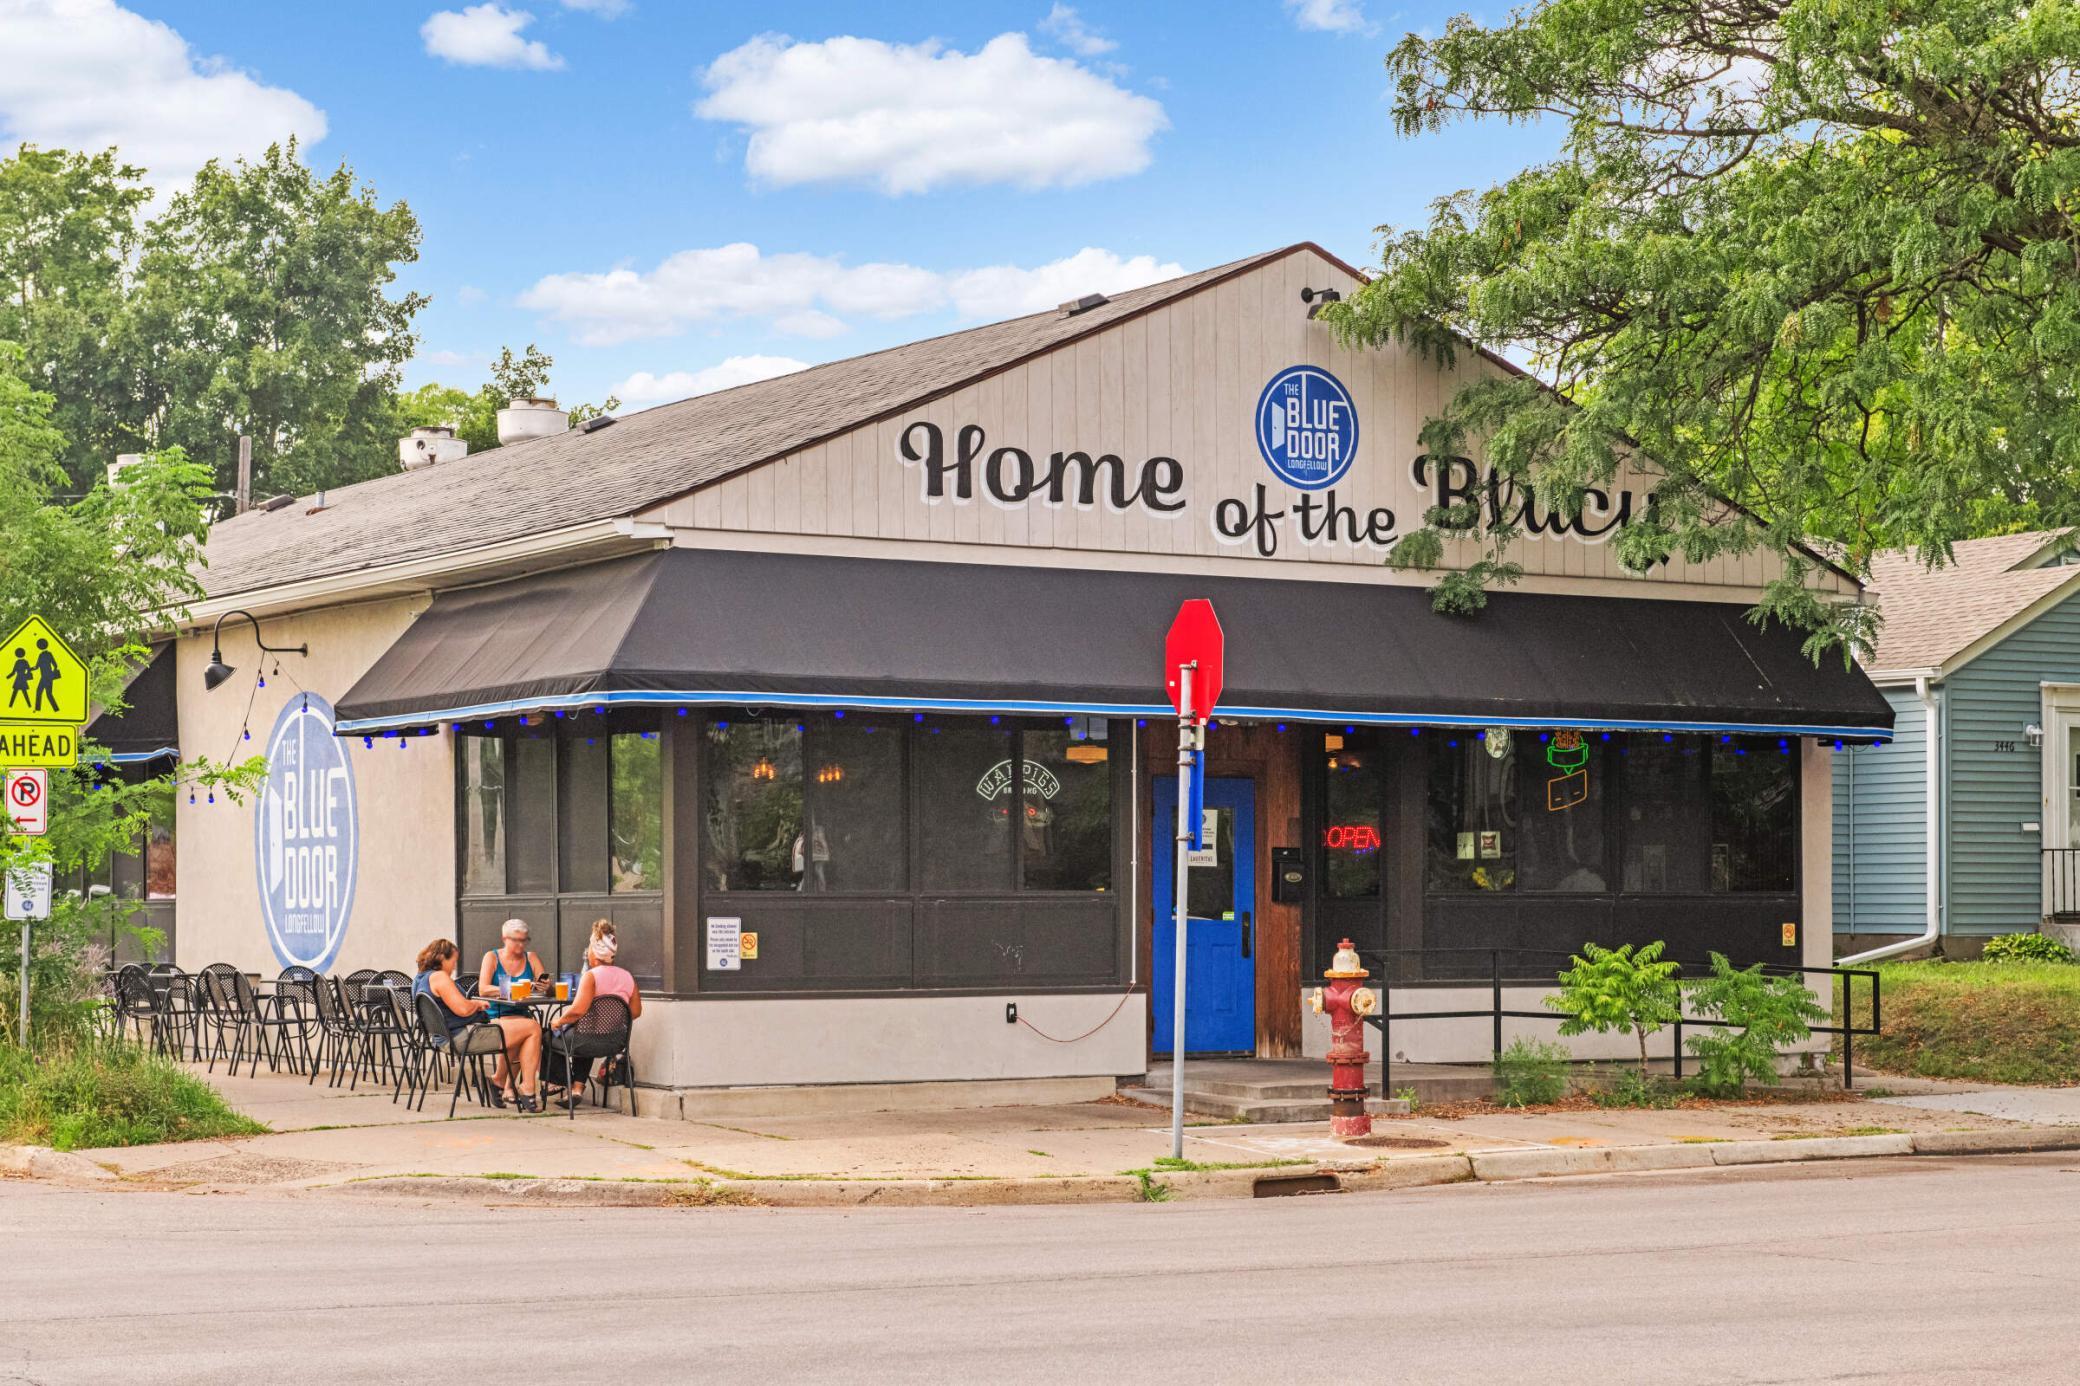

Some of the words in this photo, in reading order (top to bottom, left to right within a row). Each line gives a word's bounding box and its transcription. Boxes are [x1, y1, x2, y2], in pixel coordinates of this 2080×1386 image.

[1284, 383, 1299, 396] THE
[1287, 397, 1346, 431] BLUE
[1287, 430, 1340, 463] DOOR
[1287, 459, 1328, 471] LONGFELLOW
[899, 421, 1187, 512] Home
[1216, 482, 1285, 557] of
[1292, 489, 1399, 546] the
[0, 734, 71, 757] AHEAD
[282, 739, 297, 766] THE
[284, 768, 344, 840] BLUE
[1326, 825, 1381, 848] OPEN
[284, 845, 338, 911] DOOR
[285, 913, 325, 934] LONGFELLOW
